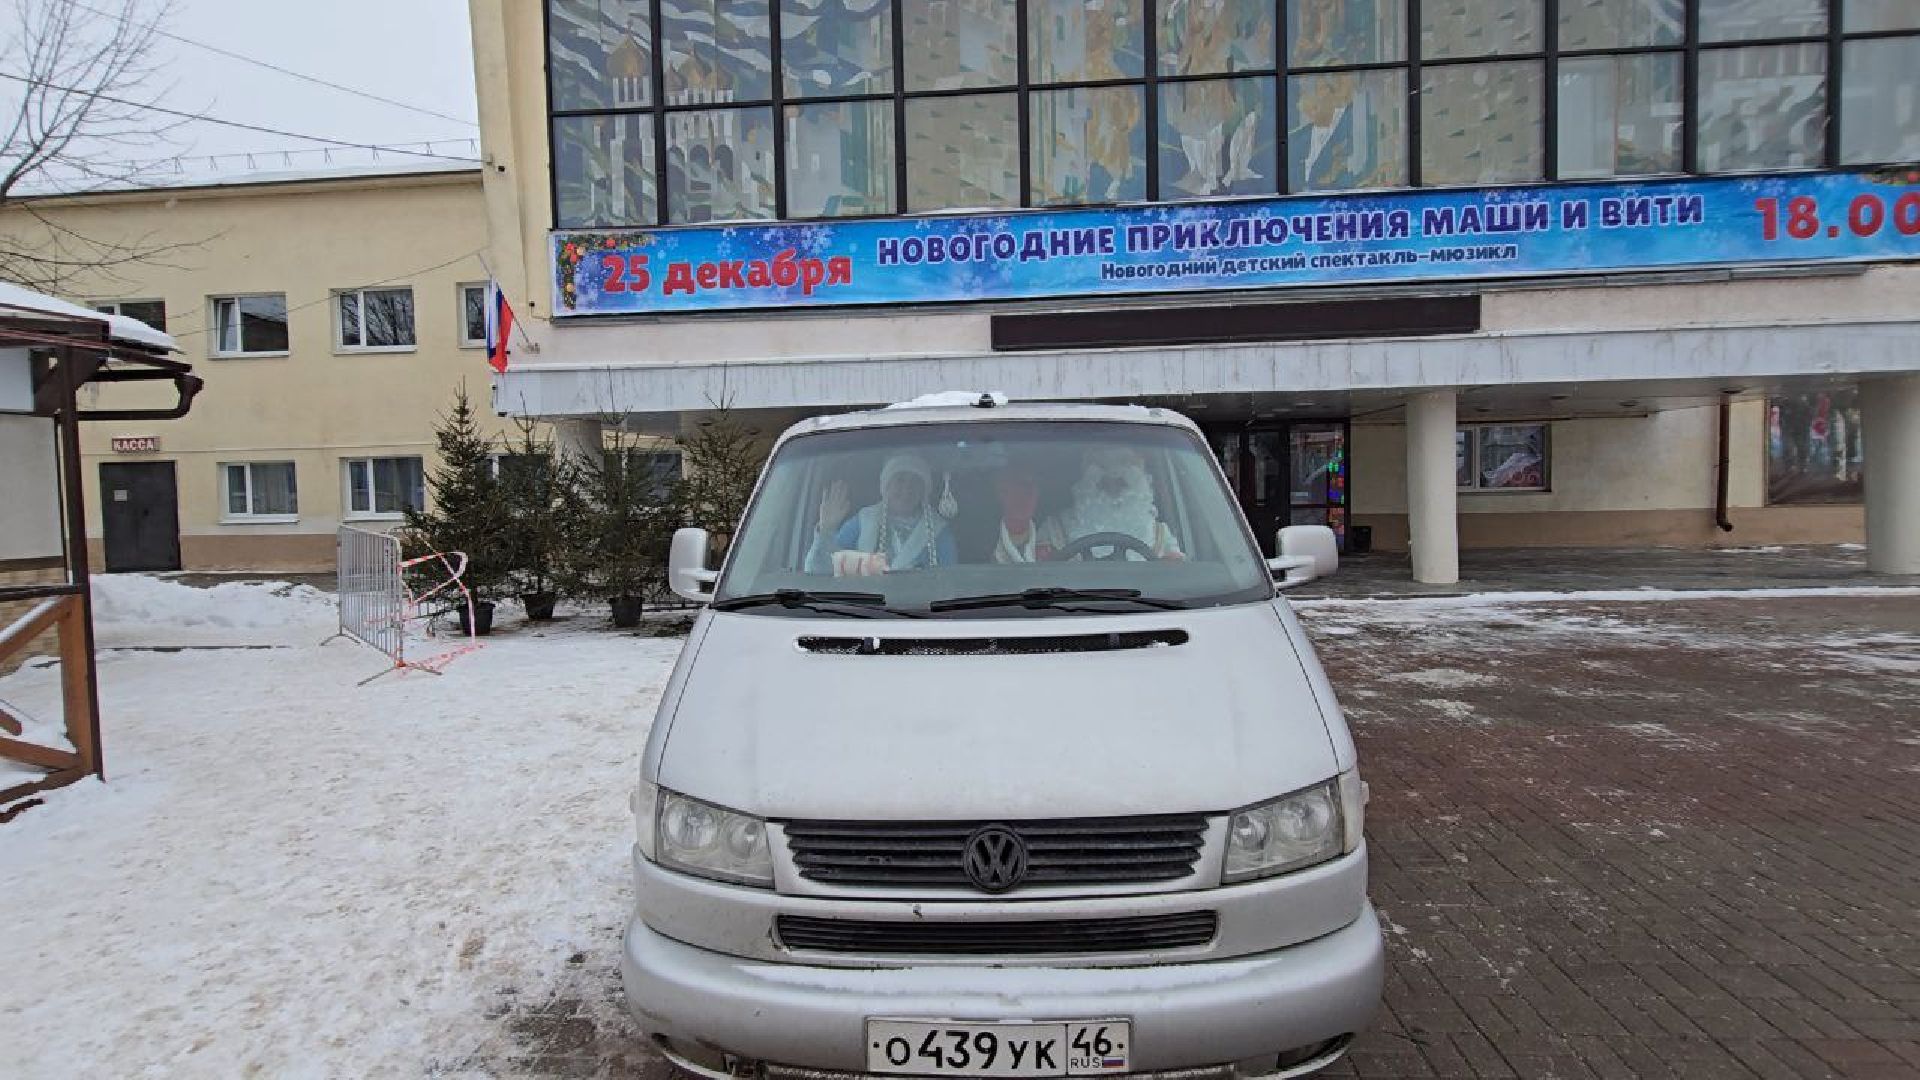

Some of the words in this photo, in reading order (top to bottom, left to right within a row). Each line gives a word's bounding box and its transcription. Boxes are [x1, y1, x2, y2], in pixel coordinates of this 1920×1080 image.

[878, 228, 1115, 265] НОВОГОДНИЕ
[1127, 210, 1409, 252] ПРИКЛЮЧЕНИЯ
[1424, 202, 1548, 236] МАШИ
[1563, 200, 1588, 229] И
[1602, 194, 1704, 227] ВИТИ
[1754, 191, 1920, 240] 18.00
[602, 255, 650, 294] 25
[663, 248, 851, 299] декабря
[1102, 259, 1217, 280] Новогодний
[1223, 254, 1306, 275] детский
[113, 439, 154, 451] КАССА
[1072, 1027, 1112, 1056] 46
[1070, 1057, 1099, 1069] RUS
